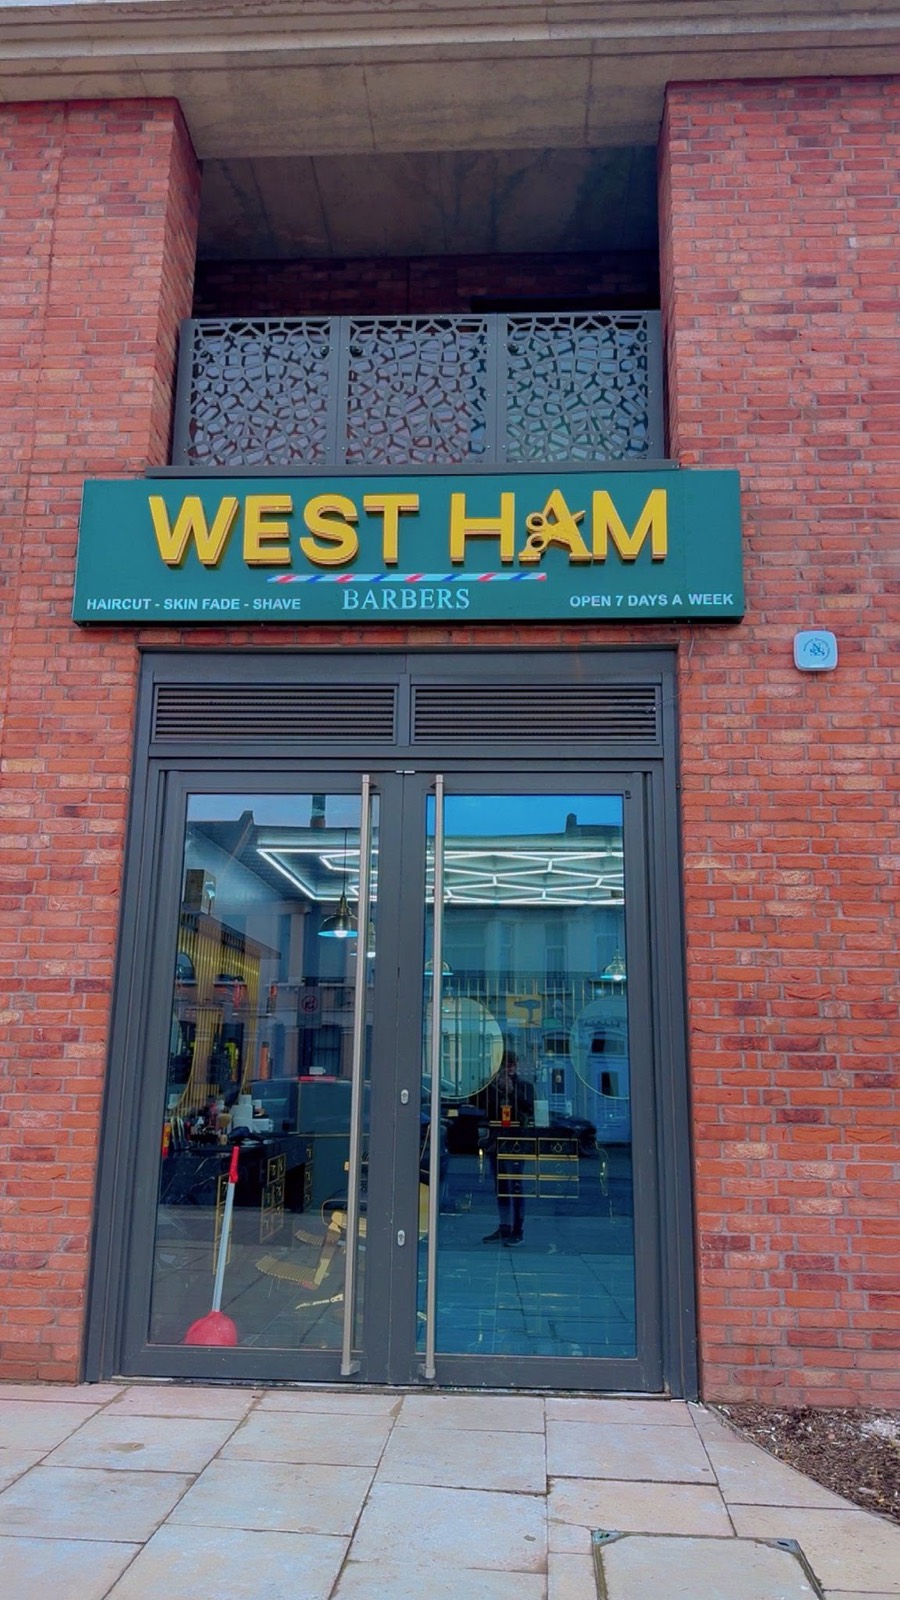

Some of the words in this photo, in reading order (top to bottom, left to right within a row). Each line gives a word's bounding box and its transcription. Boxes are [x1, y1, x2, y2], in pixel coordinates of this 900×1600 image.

[147, 494, 420, 566] WEST
[450, 489, 667, 562] HAM
[86, 598, 151, 610] HAIRCUT
[163, 598, 197, 610] SKIN
[201, 598, 240, 610] FADE
[252, 598, 301, 610] SHAVE
[342, 588, 470, 610] BARBERS
[569, 595, 611, 607] OPEN
[615, 595, 624, 606] 7
[627, 594, 668, 606] DAYS
[671, 594, 683, 606] A
[688, 593, 734, 605] WEEK
